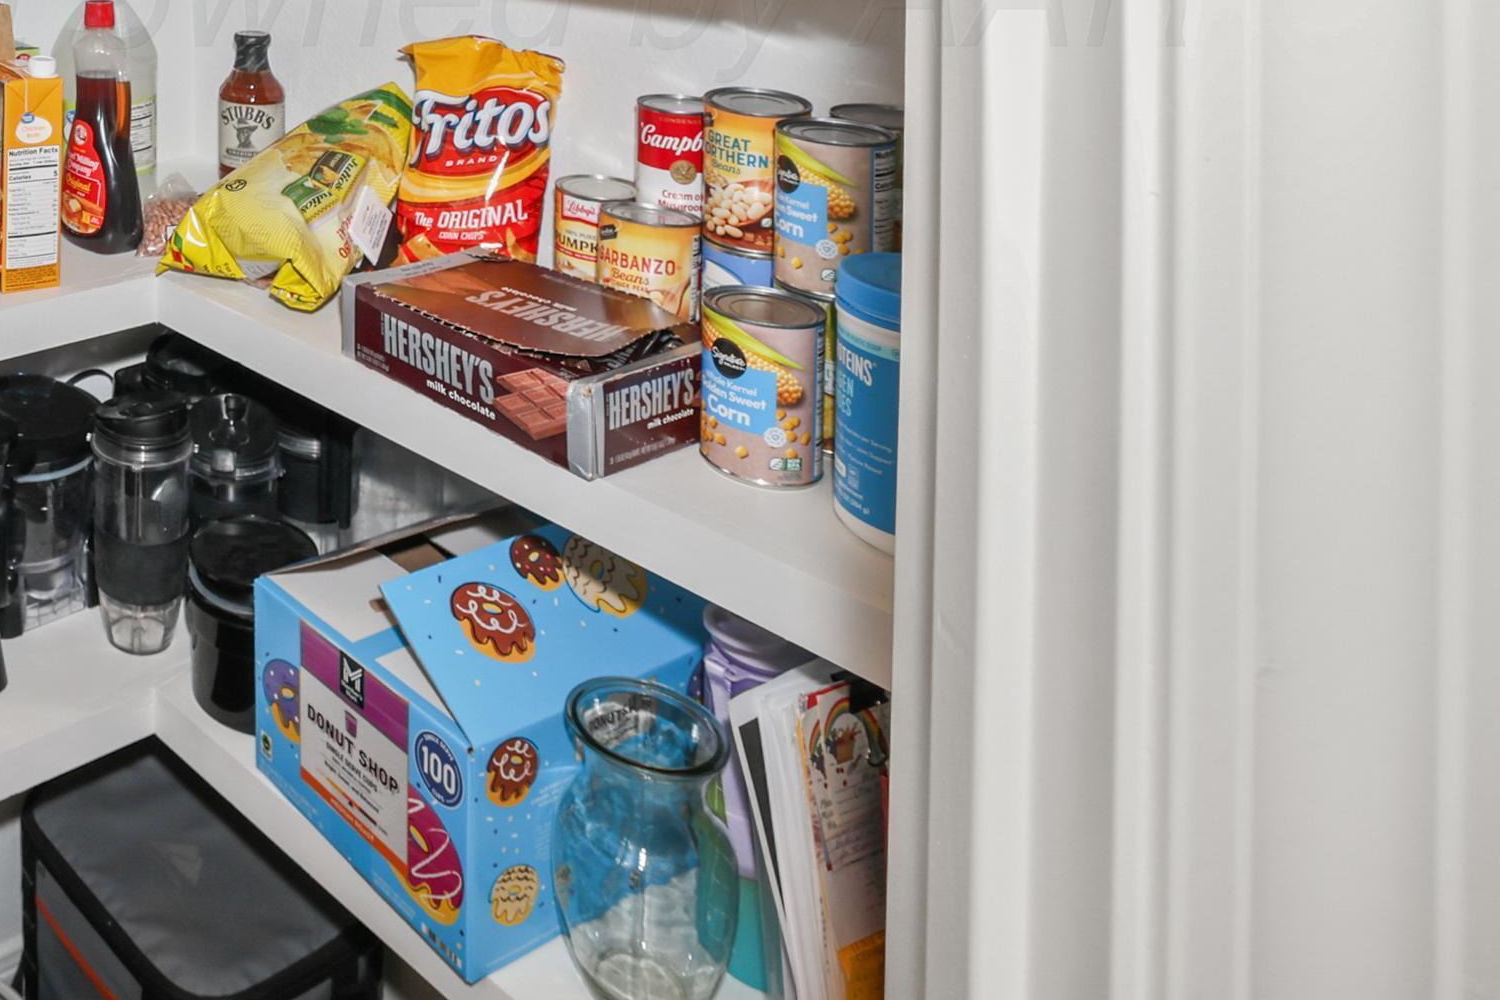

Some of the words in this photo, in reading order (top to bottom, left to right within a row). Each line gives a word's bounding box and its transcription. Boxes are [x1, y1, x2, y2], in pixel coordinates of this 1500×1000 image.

[221, 106, 275, 130] STUBB'S
[409, 90, 550, 166] Fritos
[641, 122, 703, 156] Campb
[707, 129, 751, 152] GREAT
[9, 149, 38, 157] Nutrition
[445, 155, 498, 167] BRAND
[704, 141, 769, 169] ORTHERN
[415, 211, 434, 228] The
[437, 199, 528, 229] ORIGINAL
[438, 230, 459, 240] CORN
[460, 230, 486, 241] CHIPS
[556, 234, 598, 254] UMPK
[611, 267, 650, 286] Beans
[383, 313, 495, 405] HERSHEY'S
[426, 379, 447, 396] milk
[448, 390, 497, 421] chocolate
[608, 368, 695, 431] HERSHEY'S
[727, 380, 757, 397] Kernel
[728, 391, 766, 411] Sweet
[662, 408, 695, 425] chocolate
[707, 394, 750, 427] Corn
[307, 703, 356, 756] DONUT
[358, 749, 399, 793] SHOP
[420, 745, 456, 796] 100
